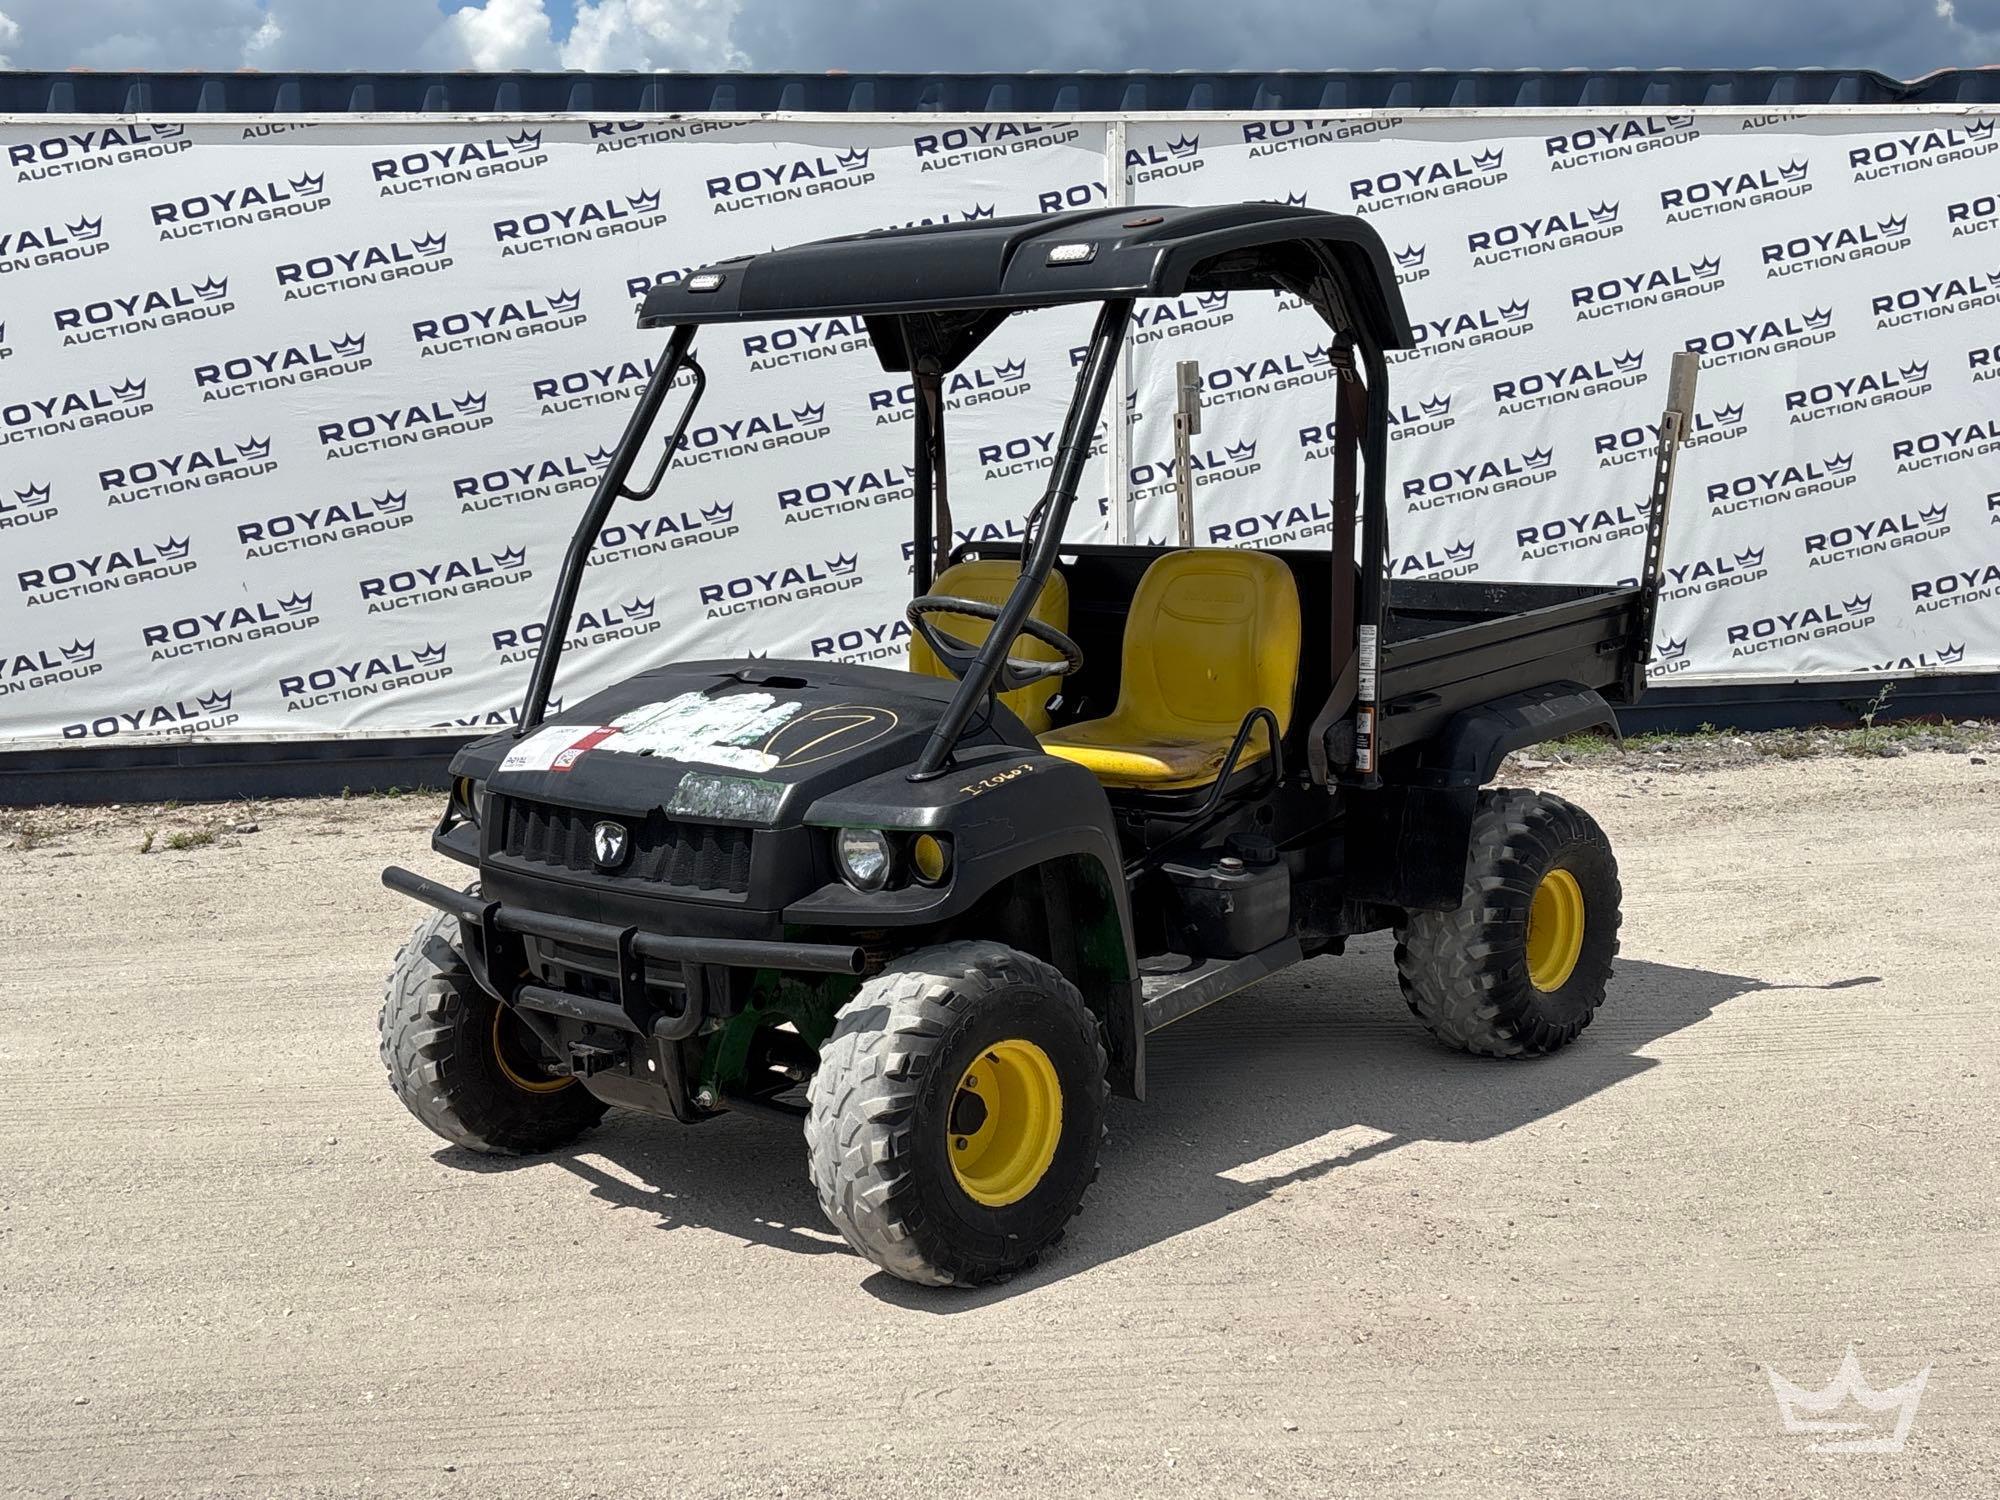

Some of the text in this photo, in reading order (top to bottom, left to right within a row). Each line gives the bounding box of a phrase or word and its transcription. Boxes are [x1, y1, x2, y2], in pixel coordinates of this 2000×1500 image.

[9, 124, 151, 166] ROYAL
[597, 127, 686, 154] AUCTION
[921, 130, 1079, 172] AUCTION GROUP
[1249, 131, 1333, 158] AUCTION
[1337, 117, 1402, 139] GROUP
[1545, 116, 1665, 156] ROYAL
[1552, 131, 1699, 171] AUCTION GROUP
[1849, 129, 1965, 168] ROYAL
[18, 140, 192, 182] AUCTION GROUP
[372, 139, 508, 181] ROYAL
[380, 155, 548, 197] AUCTION GROUP
[706, 158, 837, 198] ROYAL
[1138, 160, 1204, 182] GROUP
[1350, 159, 1472, 200] ROYAL
[1854, 143, 1998, 182] AUCTION GROUP
[151, 183, 290, 225] ROYAL
[714, 173, 874, 214] AUCTION GROUP
[1356, 173, 1507, 215] AUCTION GROUP
[1661, 170, 1778, 209] ROYAL
[1666, 184, 1812, 224] AUCTION GROUP
[160, 198, 330, 241] AUCTION GROUP
[494, 200, 628, 241] ROYAL
[502, 215, 666, 257] AUCTION GROUP
[1468, 212, 1589, 252] ROYAL
[35, 242, 109, 266] GROUP
[276, 243, 413, 285] ROYAL
[1474, 225, 1623, 267] AUCTION GROUP
[1762, 225, 1878, 264] ROYAL
[1767, 239, 1910, 278] AUCTION GROUP
[285, 258, 453, 301] AUCTION GROUP
[1572, 267, 1690, 307] ROYAL
[1872, 276, 1987, 315] ROYAL
[54, 288, 194, 330] ROYAL
[413, 300, 548, 342] ROYAL
[1577, 280, 1724, 321] AUCTION GROUP
[1877, 304, 1954, 329] AUCTION
[64, 303, 234, 346] AUCTION GROUP
[422, 315, 586, 357] AUCTION GROUP
[1168, 314, 1233, 336] GROUP
[1408, 310, 1498, 344] OYAL
[1469, 324, 1533, 345] GROUP
[194, 344, 332, 386] ROYAL
[751, 345, 836, 371] AUCTION
[1700, 331, 1835, 372] UCTION GROUP
[203, 359, 372, 402] AUCTION GROUP
[869, 370, 995, 410] ROAL
[965, 383, 1030, 405] GROUP
[1199, 384, 1270, 408] UCTION
[1493, 361, 1613, 402] ROYAL
[1499, 374, 1647, 416] AUCTION GROUP
[1786, 371, 1899, 410] ROYAL
[0, 389, 112, 432] OYAL
[542, 388, 630, 415] AUCTION
[1790, 384, 1931, 424] AUCTION GROUP
[0, 404, 153, 445] UCTION GROUP
[318, 402, 454, 445] ROYAL
[327, 417, 493, 460] AUCTION GROUP
[1391, 418, 1454, 440] GROUP
[1595, 413, 1713, 453] ROYL
[672, 427, 830, 469] AUCTION GROUP
[986, 457, 1053, 480] AUCTIO
[1898, 448, 1973, 473] AUCTION
[99, 448, 237, 490] ROYAL
[108, 462, 277, 506] AUCTION GROUP
[454, 457, 586, 498] ROYAL
[778, 469, 904, 509] ROYAL
[1196, 463, 1260, 486] GROUP
[1403, 458, 1522, 499] ROYAL
[1707, 463, 1824, 503] ROYAL
[462, 477, 597, 513] AUCTION GRO
[785, 498, 869, 524] AUCTION
[1408, 470, 1556, 513] AUCTION GROUP
[1712, 476, 1856, 517] AUCTION GROUP
[0, 508, 58, 530] ROUP
[238, 502, 374, 544] ROYAL
[246, 515, 413, 559] AUCTION GROUP
[671, 526, 739, 548] GROUP
[1209, 503, 1329, 544] ROYAL
[1517, 507, 1635, 547] ROYAL
[1805, 514, 1919, 553] ROYAL
[1522, 522, 1648, 561] AUCTION GRO
[1809, 526, 1950, 567] AUCTION GROUP
[18, 548, 156, 591] ROYAL
[27, 561, 196, 606] AUCTION GROUP
[360, 557, 494, 599] ROYAL
[700, 564, 826, 605] ROYAL
[1706, 570, 1767, 591] GROUP
[1912, 566, 2000, 600] ROYA
[368, 571, 532, 614] AUCTION GROUP
[707, 577, 862, 619] AUCTION GROUP
[1916, 588, 1991, 614] AUCTION
[143, 603, 280, 646] ROYAL
[152, 617, 319, 661] AUCTION GROUP
[493, 608, 623, 649] ROAL
[592, 622, 660, 644] GROUP
[812, 621, 910, 657] ROYA
[1727, 605, 1842, 644] ROYAL
[1733, 617, 1875, 657] AUCTION GROUP
[30, 664, 102, 688] GROUP
[279, 654, 414, 697] ROYAL
[288, 667, 452, 712] AUCTION GROUP
